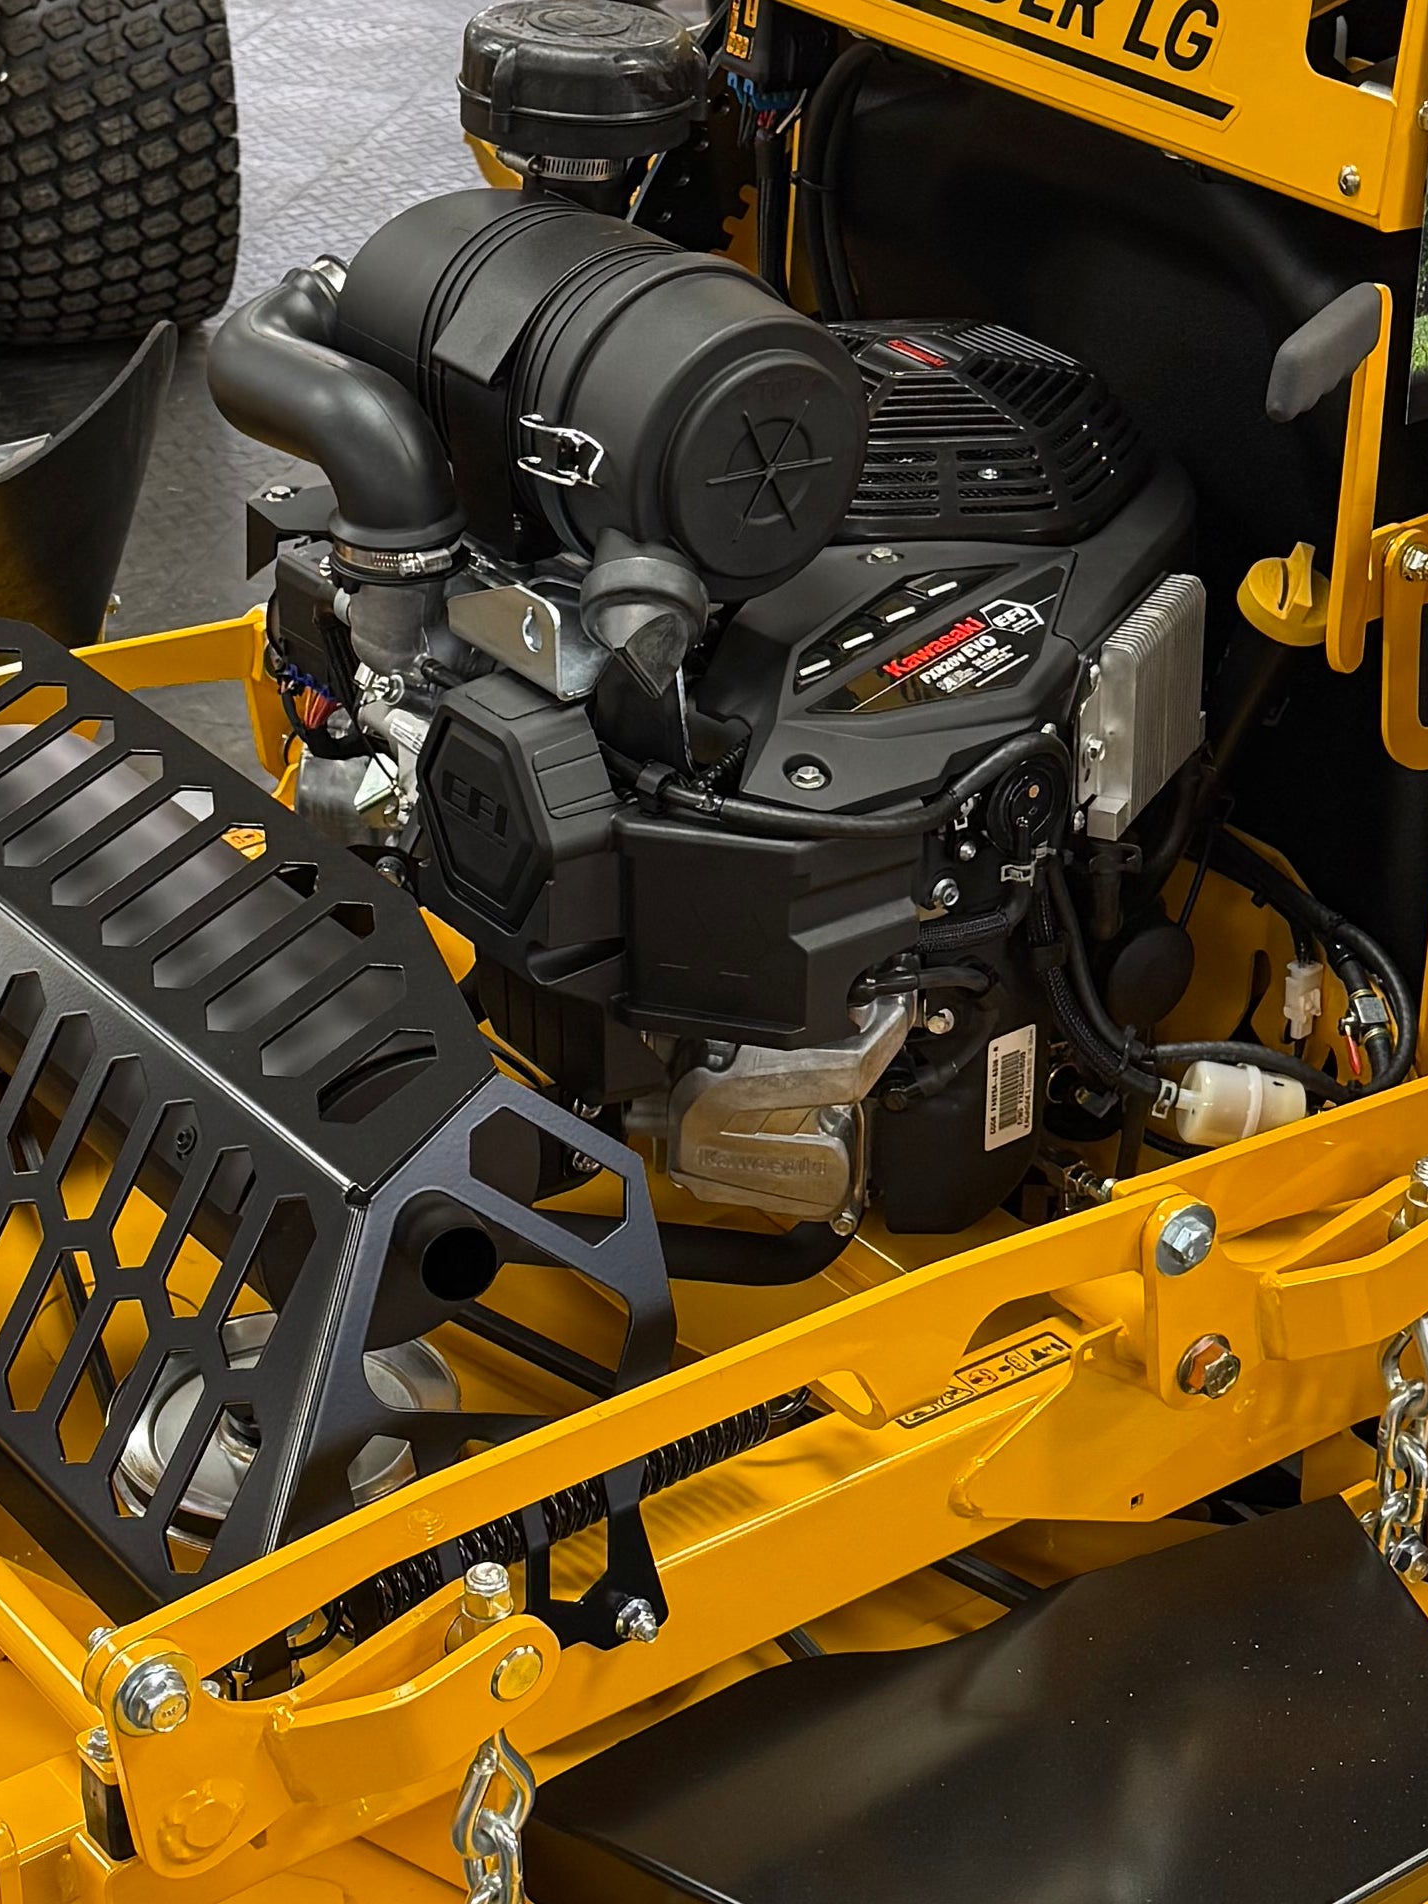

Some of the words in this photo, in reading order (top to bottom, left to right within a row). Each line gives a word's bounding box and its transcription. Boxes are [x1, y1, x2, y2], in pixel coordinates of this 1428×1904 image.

[992, 606, 1028, 629] EFI
[882, 616, 986, 678] Kawasaki
[966, 635, 997, 659] EVO
[441, 769, 509, 839] EFI
